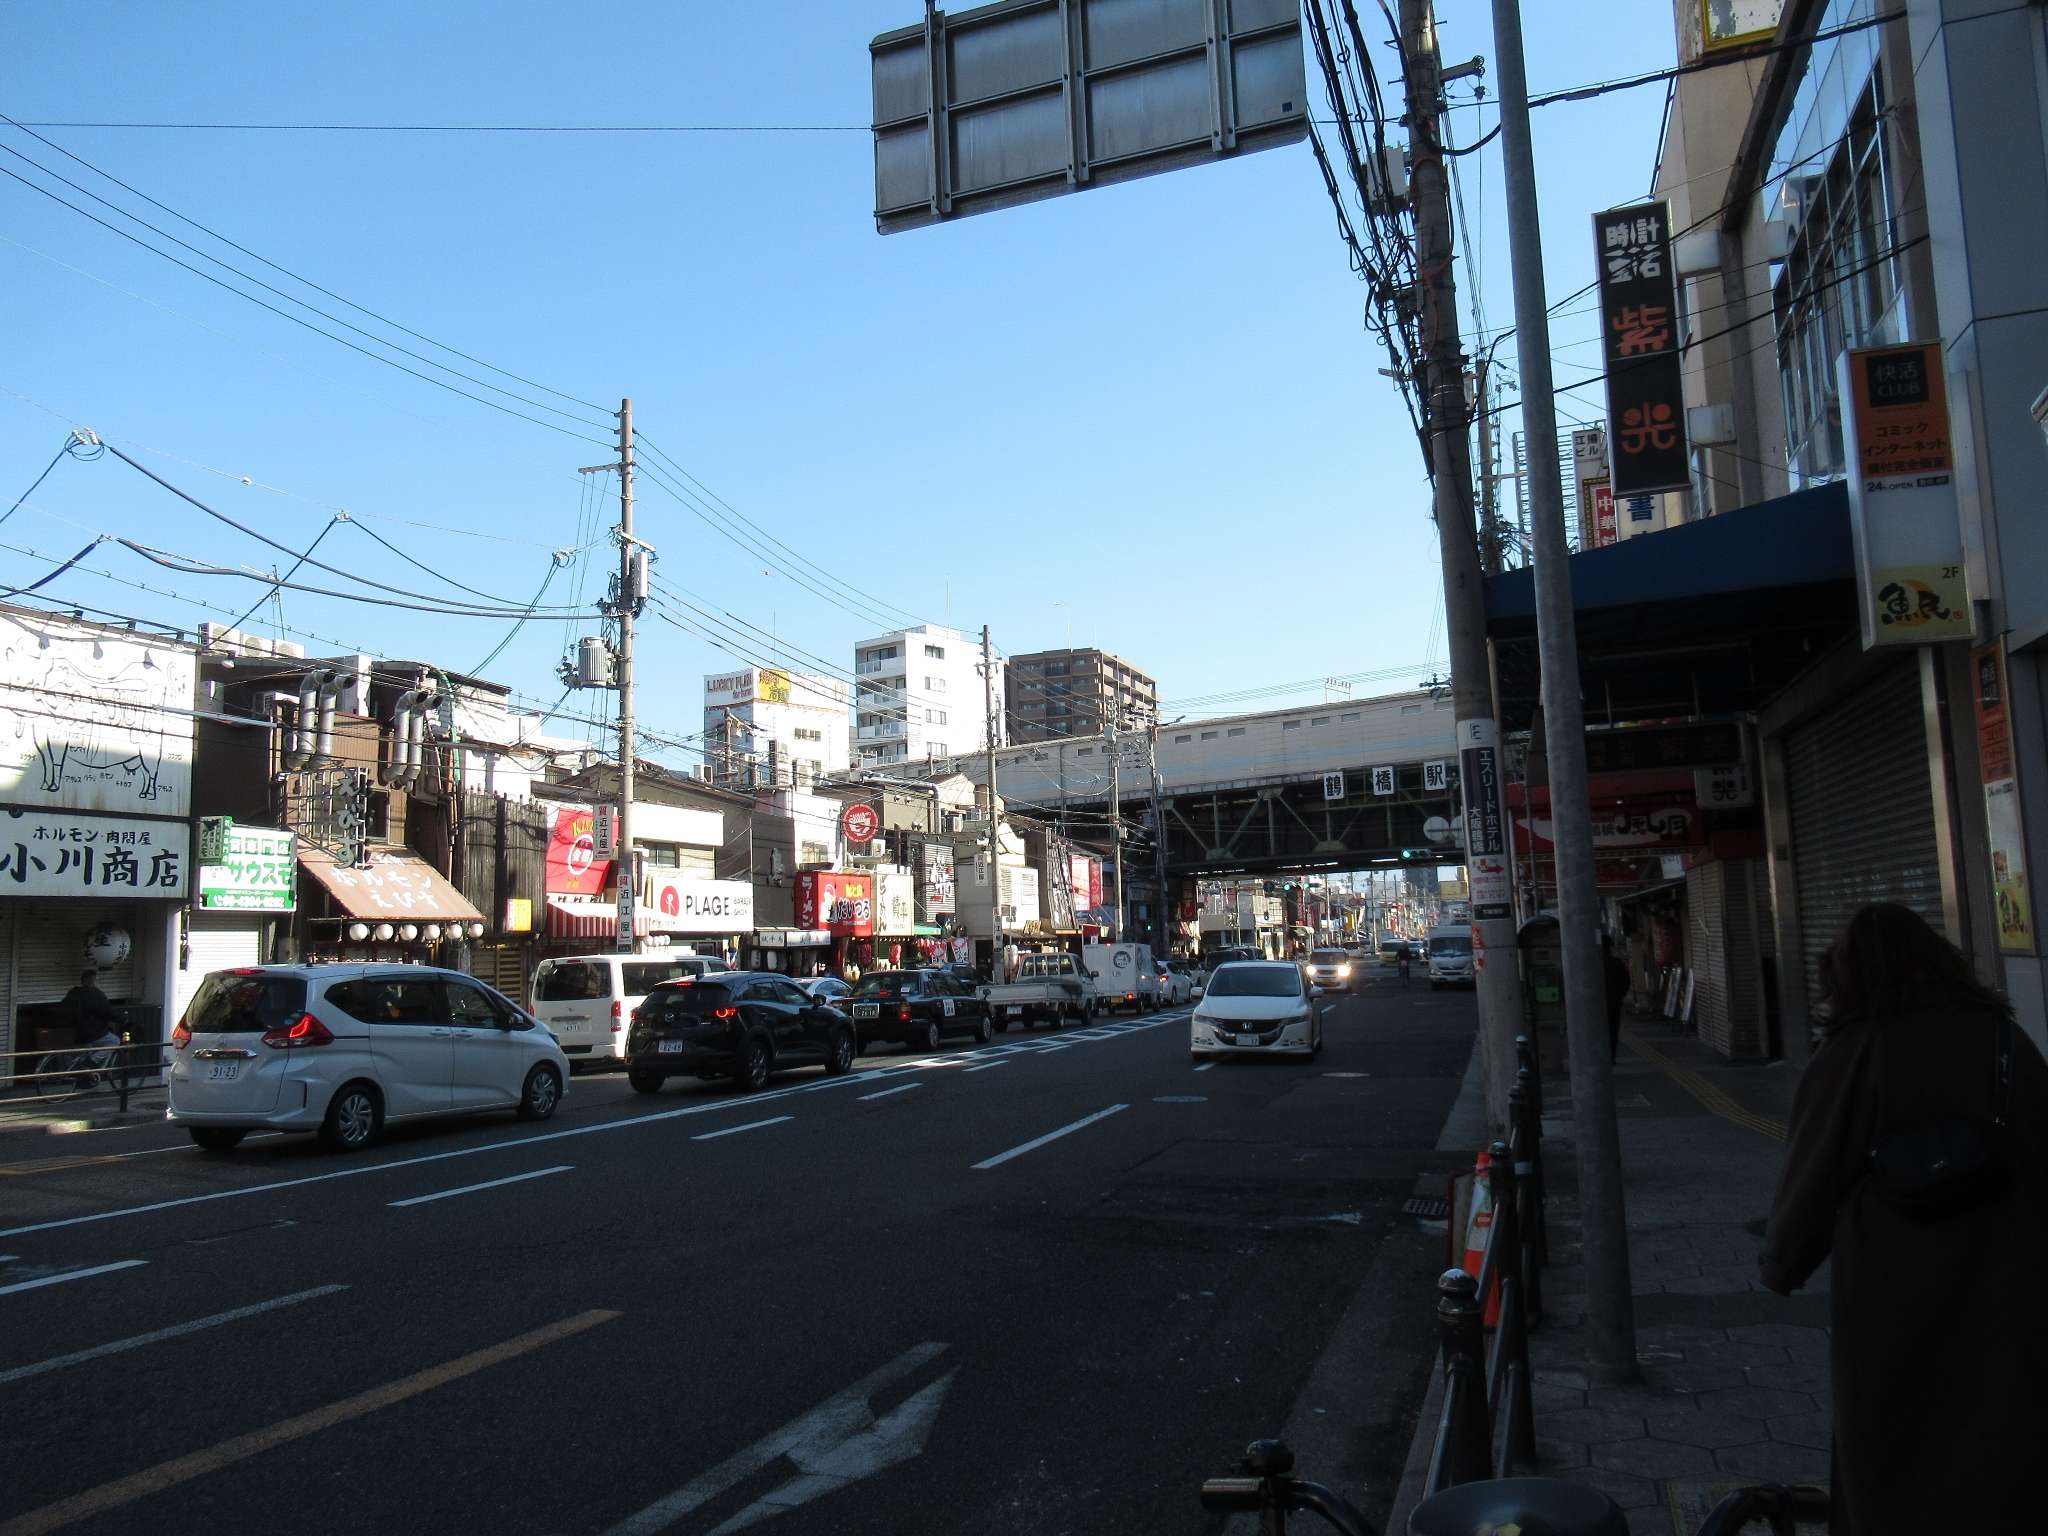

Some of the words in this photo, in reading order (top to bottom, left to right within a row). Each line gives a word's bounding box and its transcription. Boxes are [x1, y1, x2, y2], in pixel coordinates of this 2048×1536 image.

[1605, 216, 1661, 248] 時計
[1874, 360, 1919, 383] 快活
[1877, 380, 1921, 398] CLUB
[1875, 421, 1929, 438] コミック
[1863, 438, 1947, 457] インターネット
[1941, 566, 1959, 579] 2F
[1878, 582, 1951, 625] 魚民
[1325, 765, 1444, 797] 鶴橋駅
[1480, 750, 1500, 853] エスリードホテル
[333, 768, 363, 869] えびす
[32, 826, 153, 846] ホルモン・肉問屋
[0, 842, 179, 888] 小川商店
[686, 895, 730, 916] PLAGE
[801, 875, 814, 924] ラーメン
